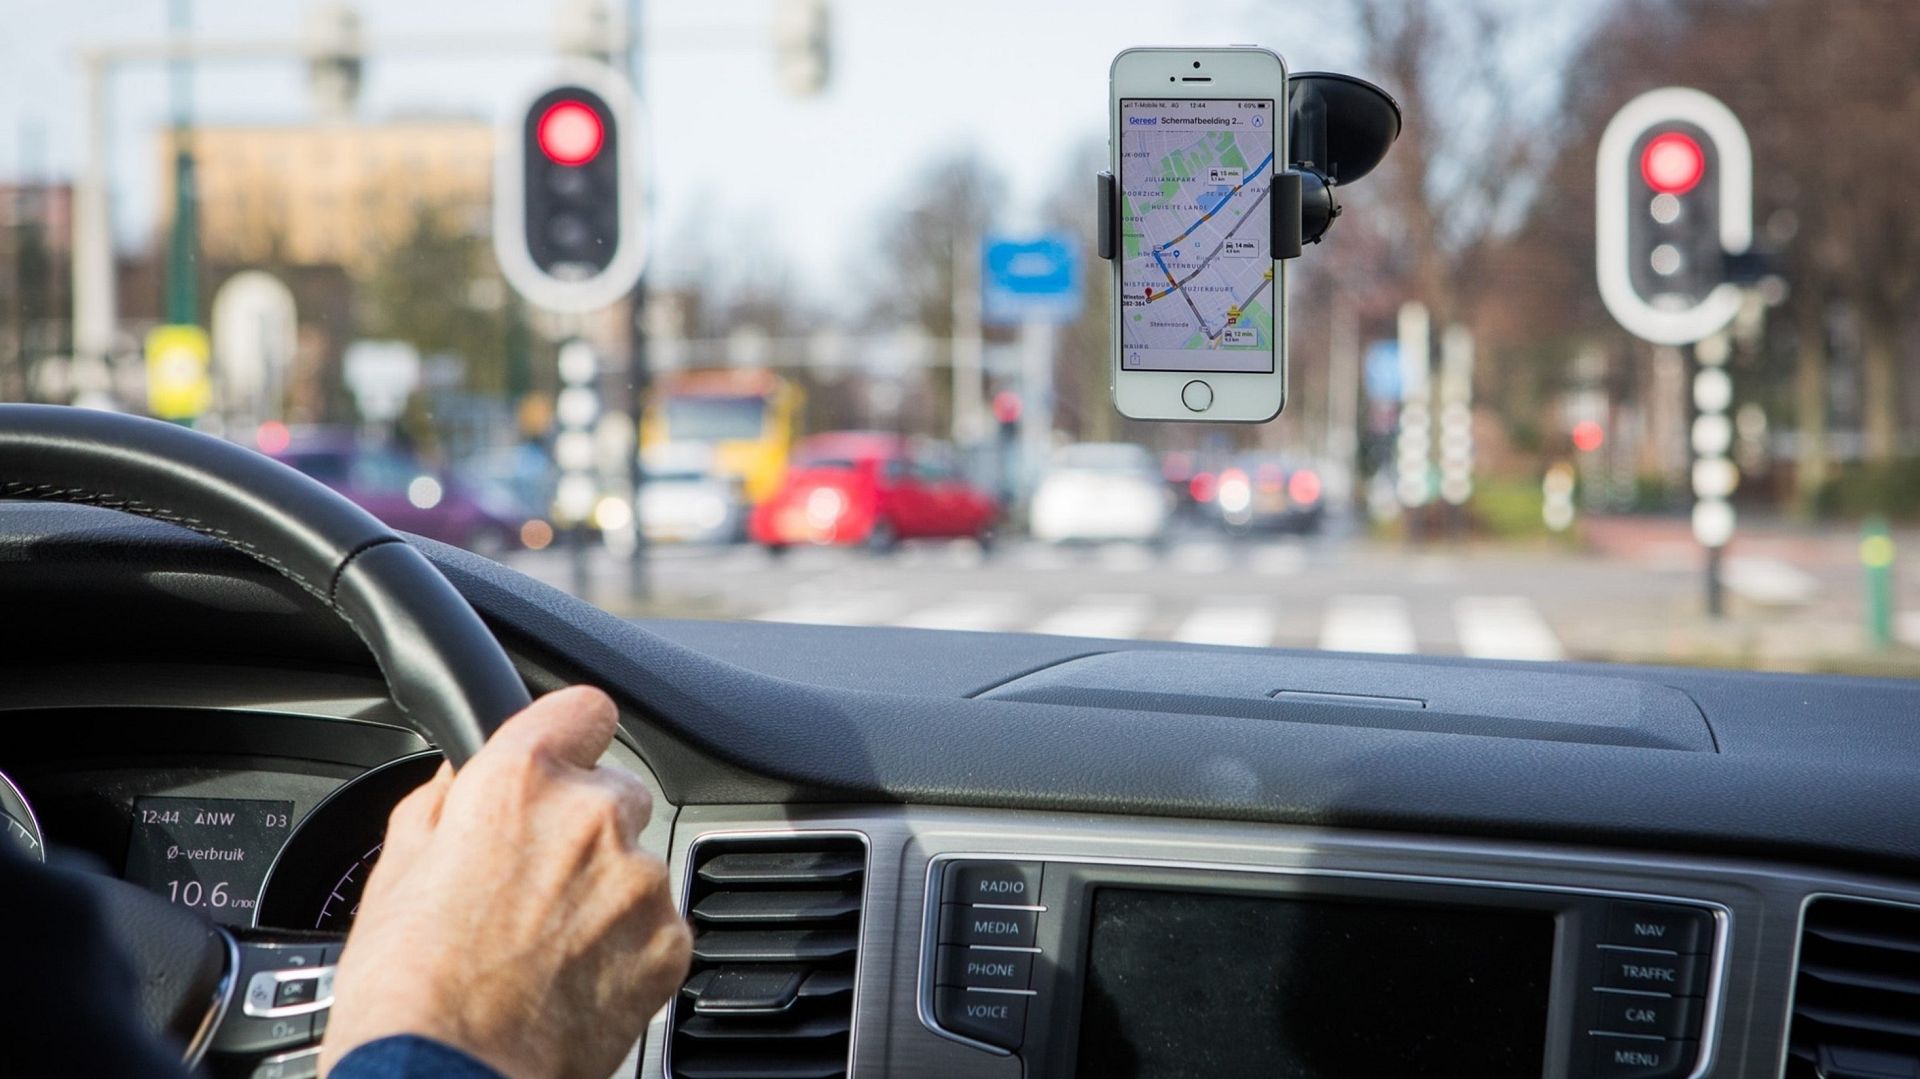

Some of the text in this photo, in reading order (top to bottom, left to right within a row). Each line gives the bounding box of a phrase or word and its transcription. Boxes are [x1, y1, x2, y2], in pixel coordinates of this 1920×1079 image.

[1129, 116, 1157, 125] Gereed
[1161, 116, 1230, 126] Schermafbeelding
[141, 809, 181, 825] 12:44
[166, 845, 245, 862] Ø-verbruik
[168, 879, 230, 908] 10.6
[980, 879, 1024, 894] RADIO
[974, 920, 1020, 935] MEDIA
[1634, 922, 1666, 937] NAV
[967, 962, 1015, 977] PHONE
[1622, 963, 1677, 982] TRAFFIC
[967, 1004, 1009, 1019] VOICE
[1625, 1007, 1656, 1023] CAR
[1614, 1049, 1660, 1067] MENU
